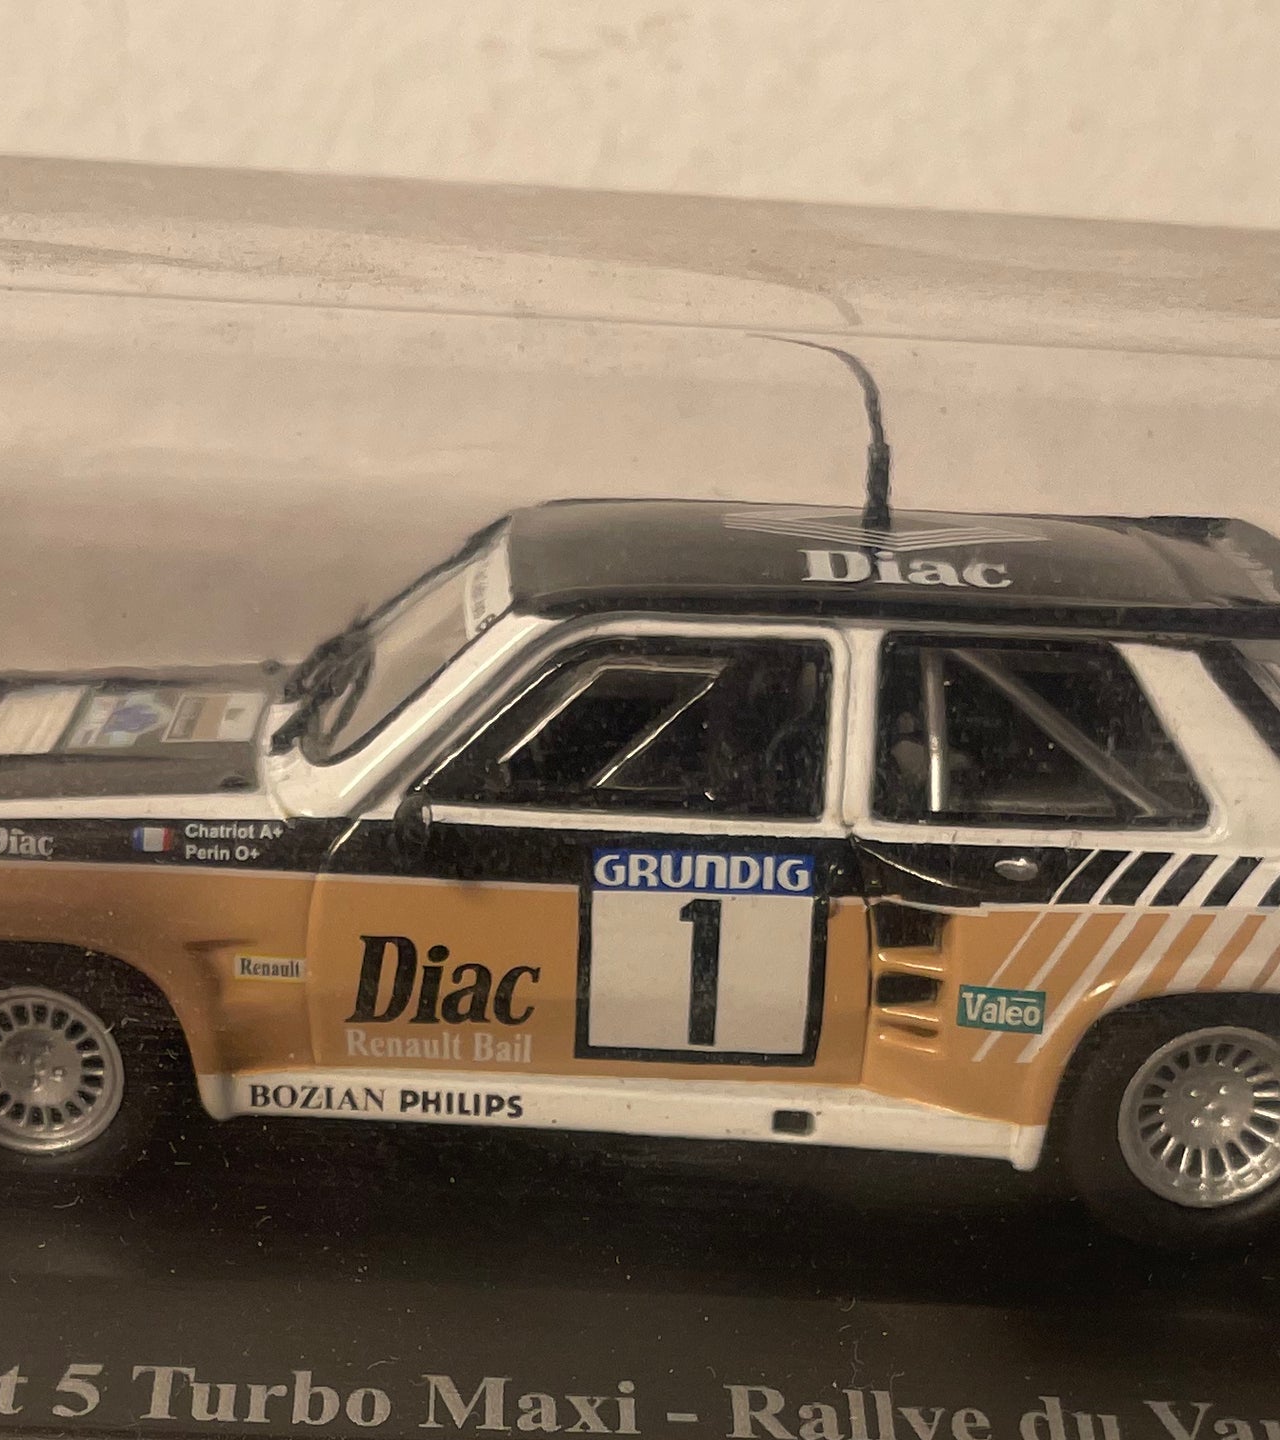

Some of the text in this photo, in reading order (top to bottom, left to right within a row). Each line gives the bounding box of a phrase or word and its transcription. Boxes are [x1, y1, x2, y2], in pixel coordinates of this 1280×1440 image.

[798, 549, 1012, 588] Diac
[185, 822, 283, 839] Chatriot A+
[185, 844, 230, 861] Perin
[594, 853, 811, 891] GRUNDIG
[240, 957, 301, 979] Renault
[345, 934, 541, 1026] Diac
[679, 898, 723, 1046] 1
[962, 991, 1041, 1027] Valeo
[346, 1028, 533, 1064] Renault Bail
[249, 1083, 524, 1117] BOZIAN PHILIPS
[52, 1363, 106, 1416] 5
[133, 1365, 391, 1426] Turbo
[419, 1373, 642, 1435] Maxi
